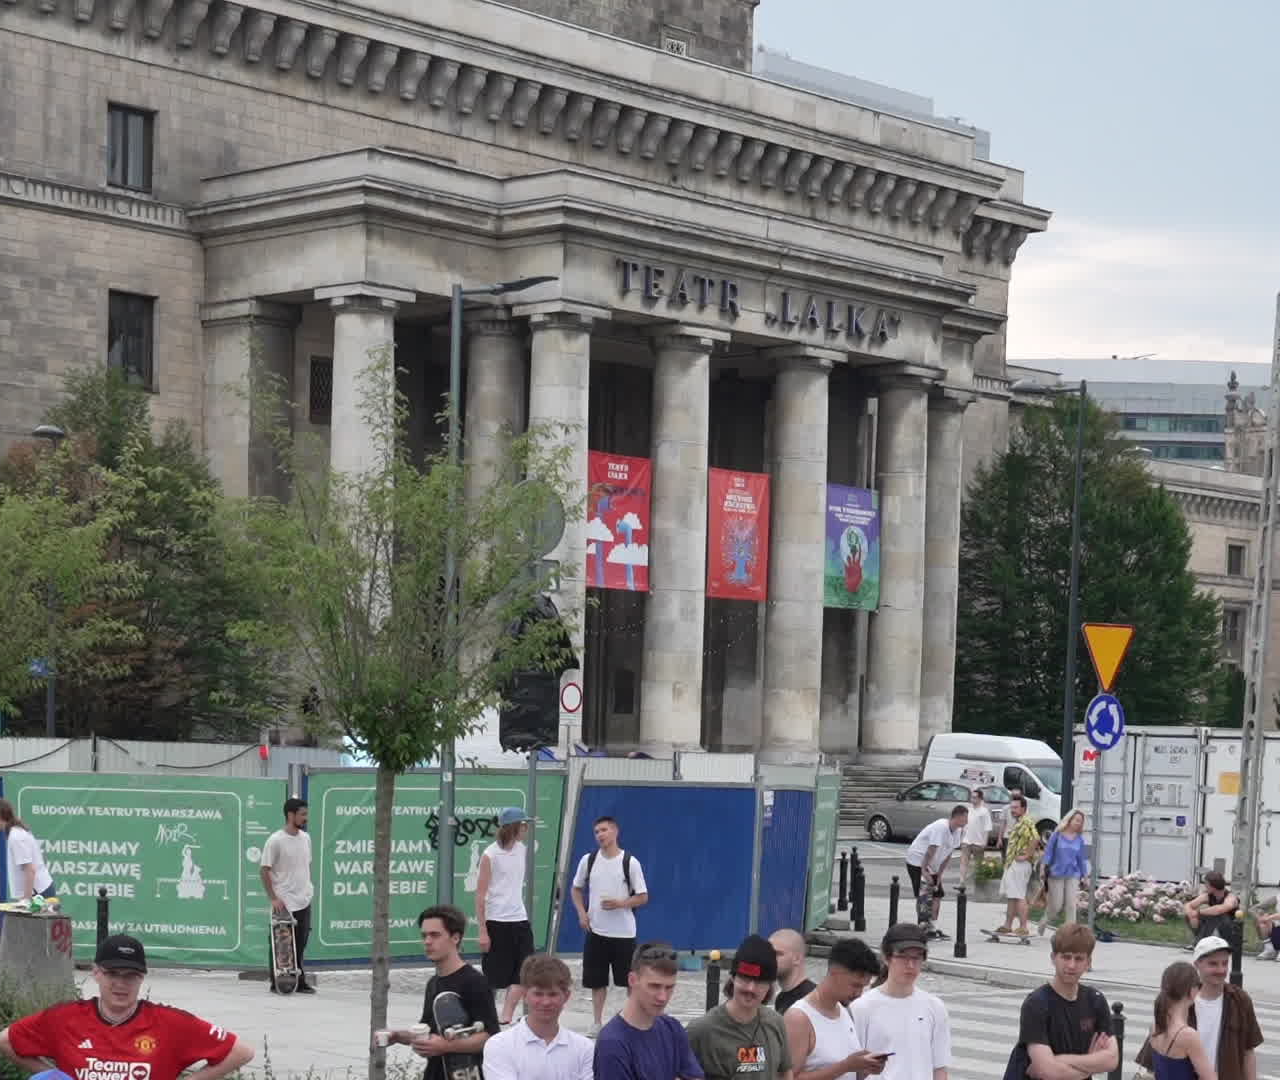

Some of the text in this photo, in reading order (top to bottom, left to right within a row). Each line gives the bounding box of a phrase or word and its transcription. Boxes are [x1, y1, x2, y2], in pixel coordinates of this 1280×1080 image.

[616, 259, 739, 318] TEATR
[32, 805, 222, 821] BUDOWA TEATRU TR WARSZAWA
[336, 806, 376, 816] BUDOW
[335, 840, 432, 854] ZMIEIAMY
[334, 861, 435, 877] WARZAWĘ
[333, 881, 369, 895] DLA
[127, 922, 142, 933] ZA
[144, 923, 227, 936] UTRUDNIENIA
[86, 1057, 129, 1072] Team
